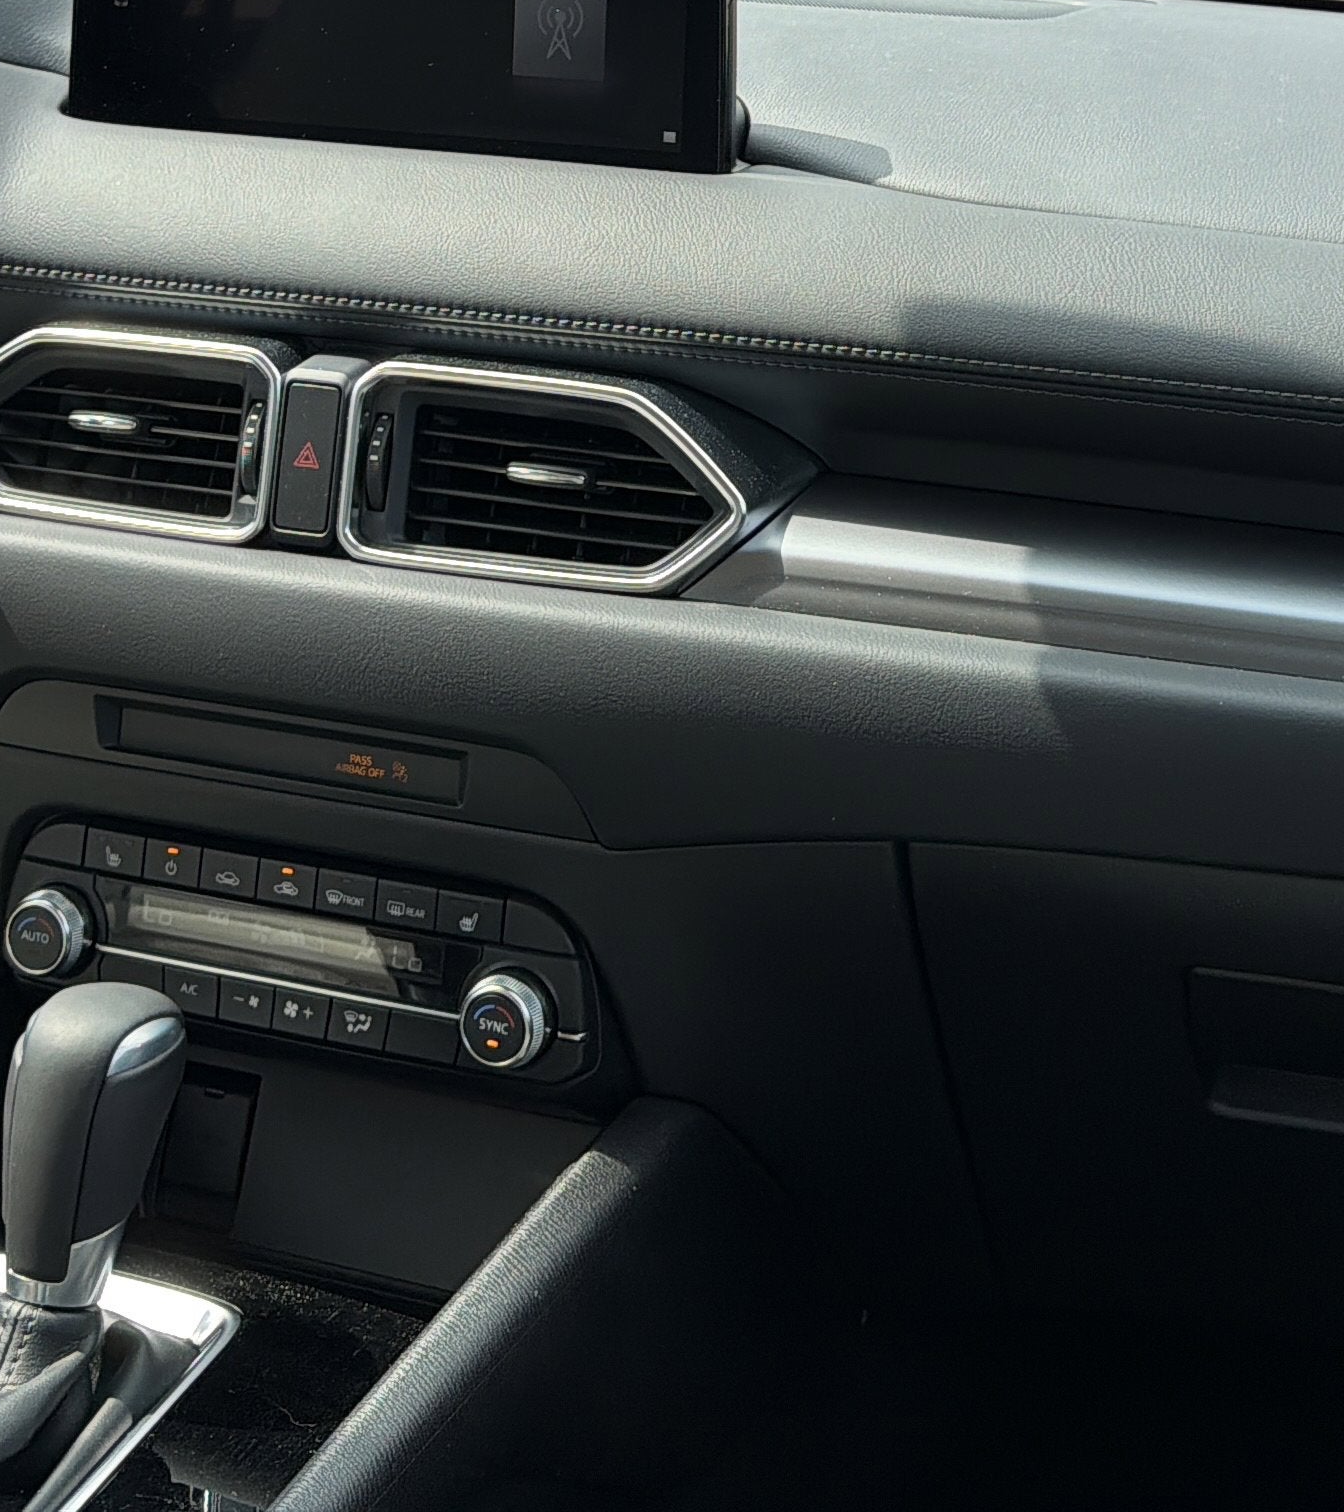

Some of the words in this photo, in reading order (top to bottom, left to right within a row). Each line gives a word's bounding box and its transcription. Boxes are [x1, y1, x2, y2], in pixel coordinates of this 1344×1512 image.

[349, 753, 373, 767] PASS
[335, 762, 366, 777] AIRBAG
[367, 768, 386, 779] OFF
[342, 897, 365, 907] FRONT
[405, 906, 426, 919] REAR
[20, 929, 50, 945] AUTO
[180, 982, 199, 996] A/C
[478, 1016, 509, 1036] SYNC
